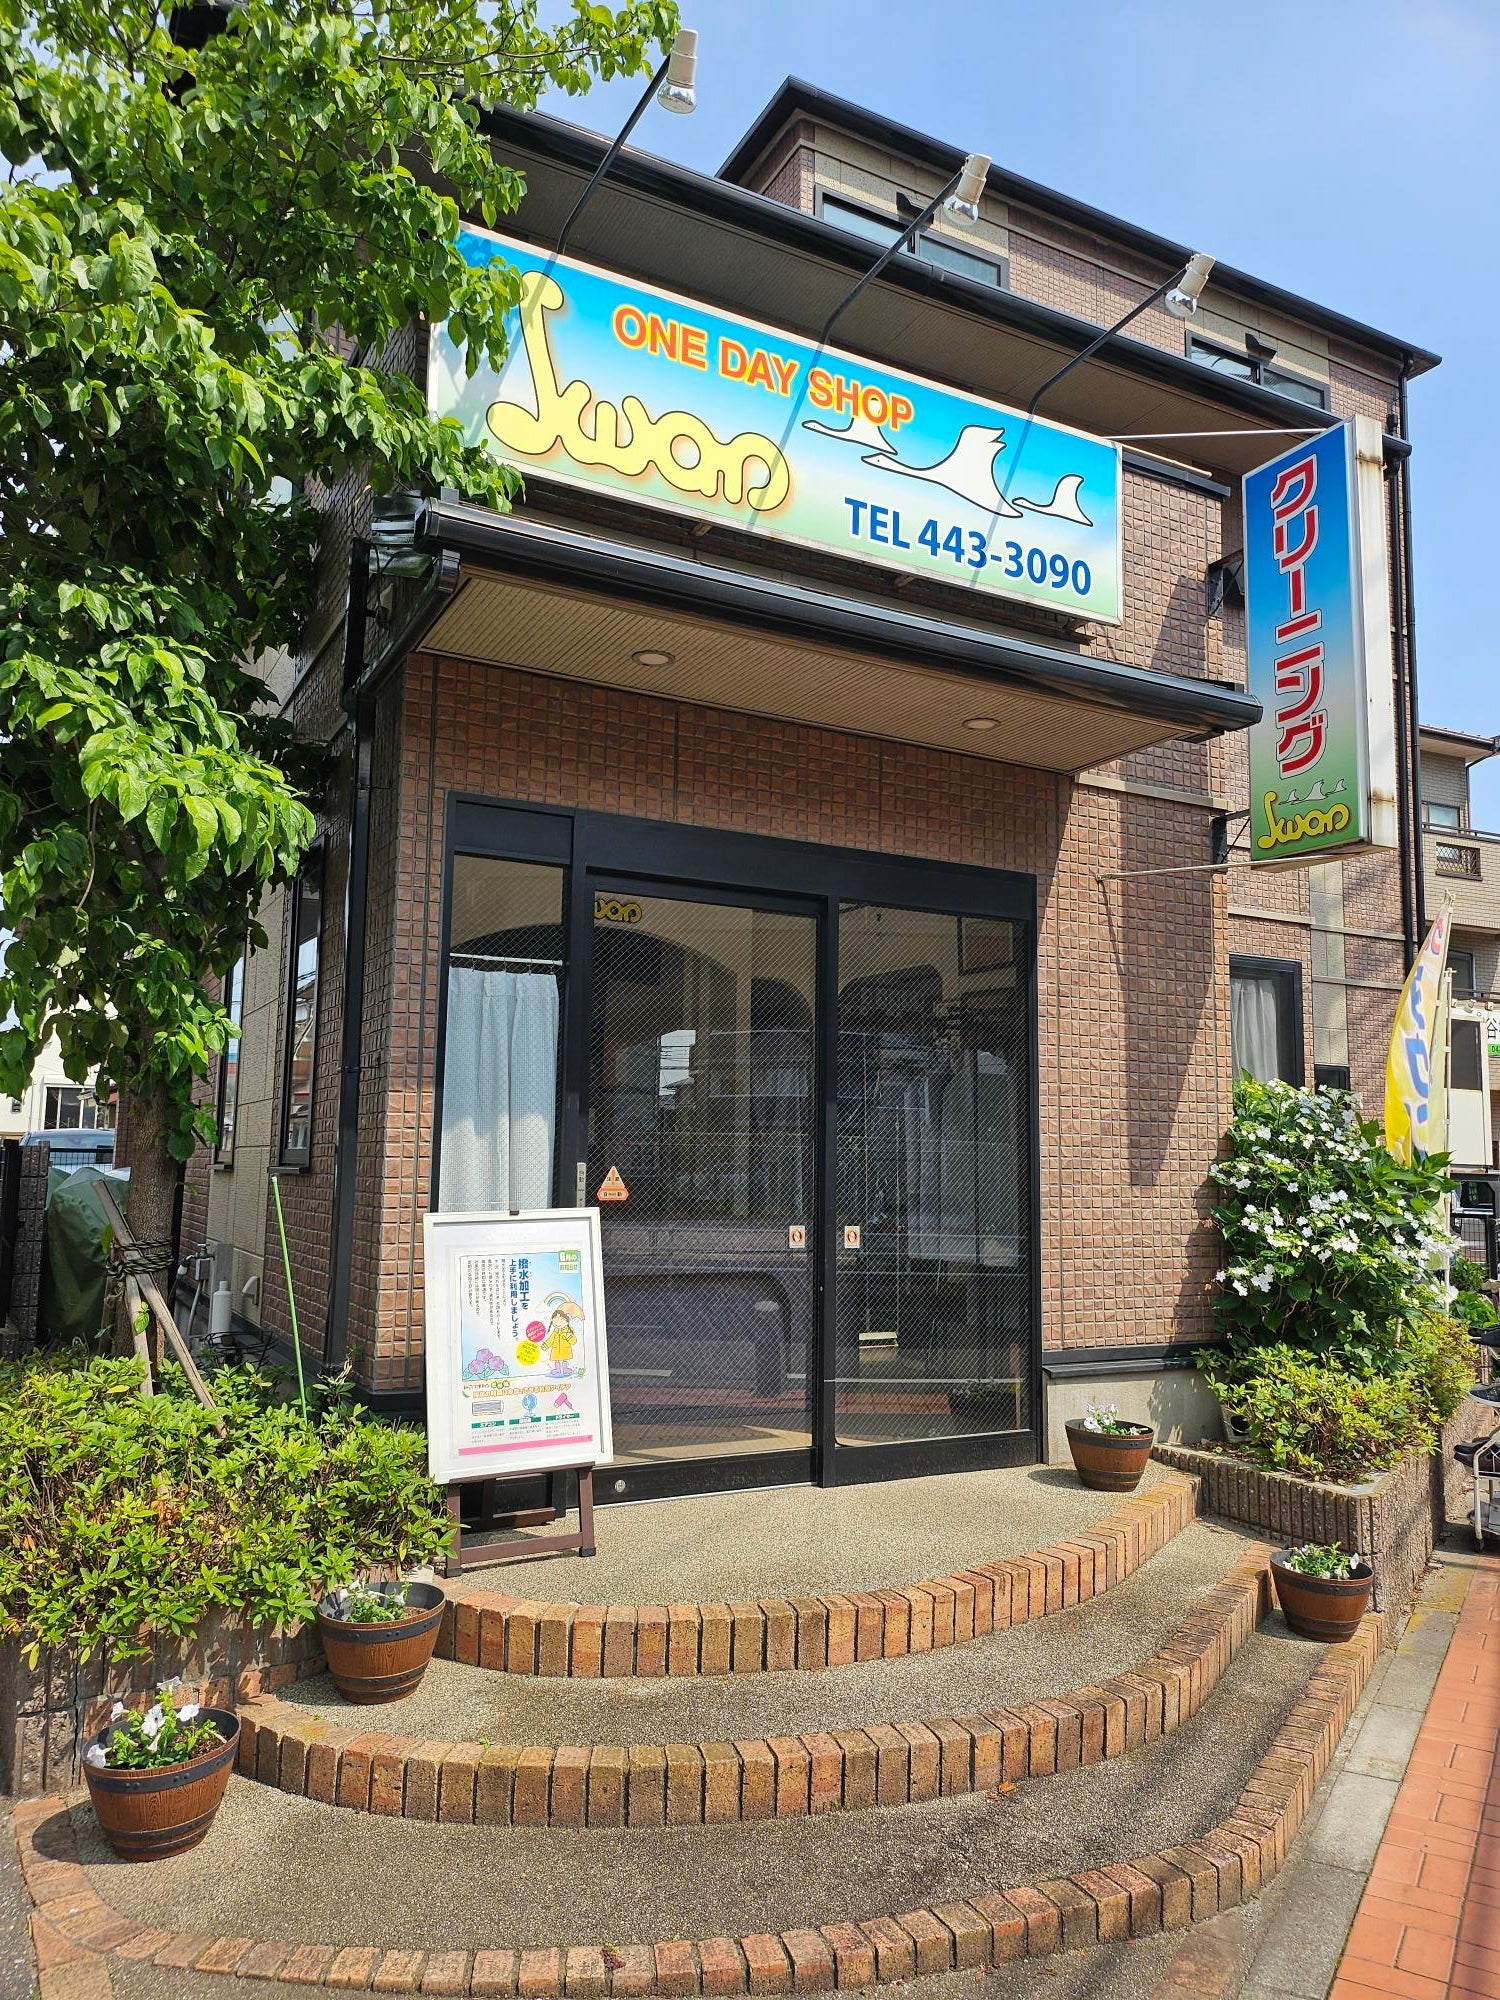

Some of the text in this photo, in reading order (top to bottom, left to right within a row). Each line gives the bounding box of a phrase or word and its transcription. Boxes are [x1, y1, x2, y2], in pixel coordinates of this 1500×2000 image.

[614, 306, 913, 431] ONE DAY SHOP
[844, 497, 1092, 595] TEL 443-3090
[1270, 455, 1327, 778] クリーニング
